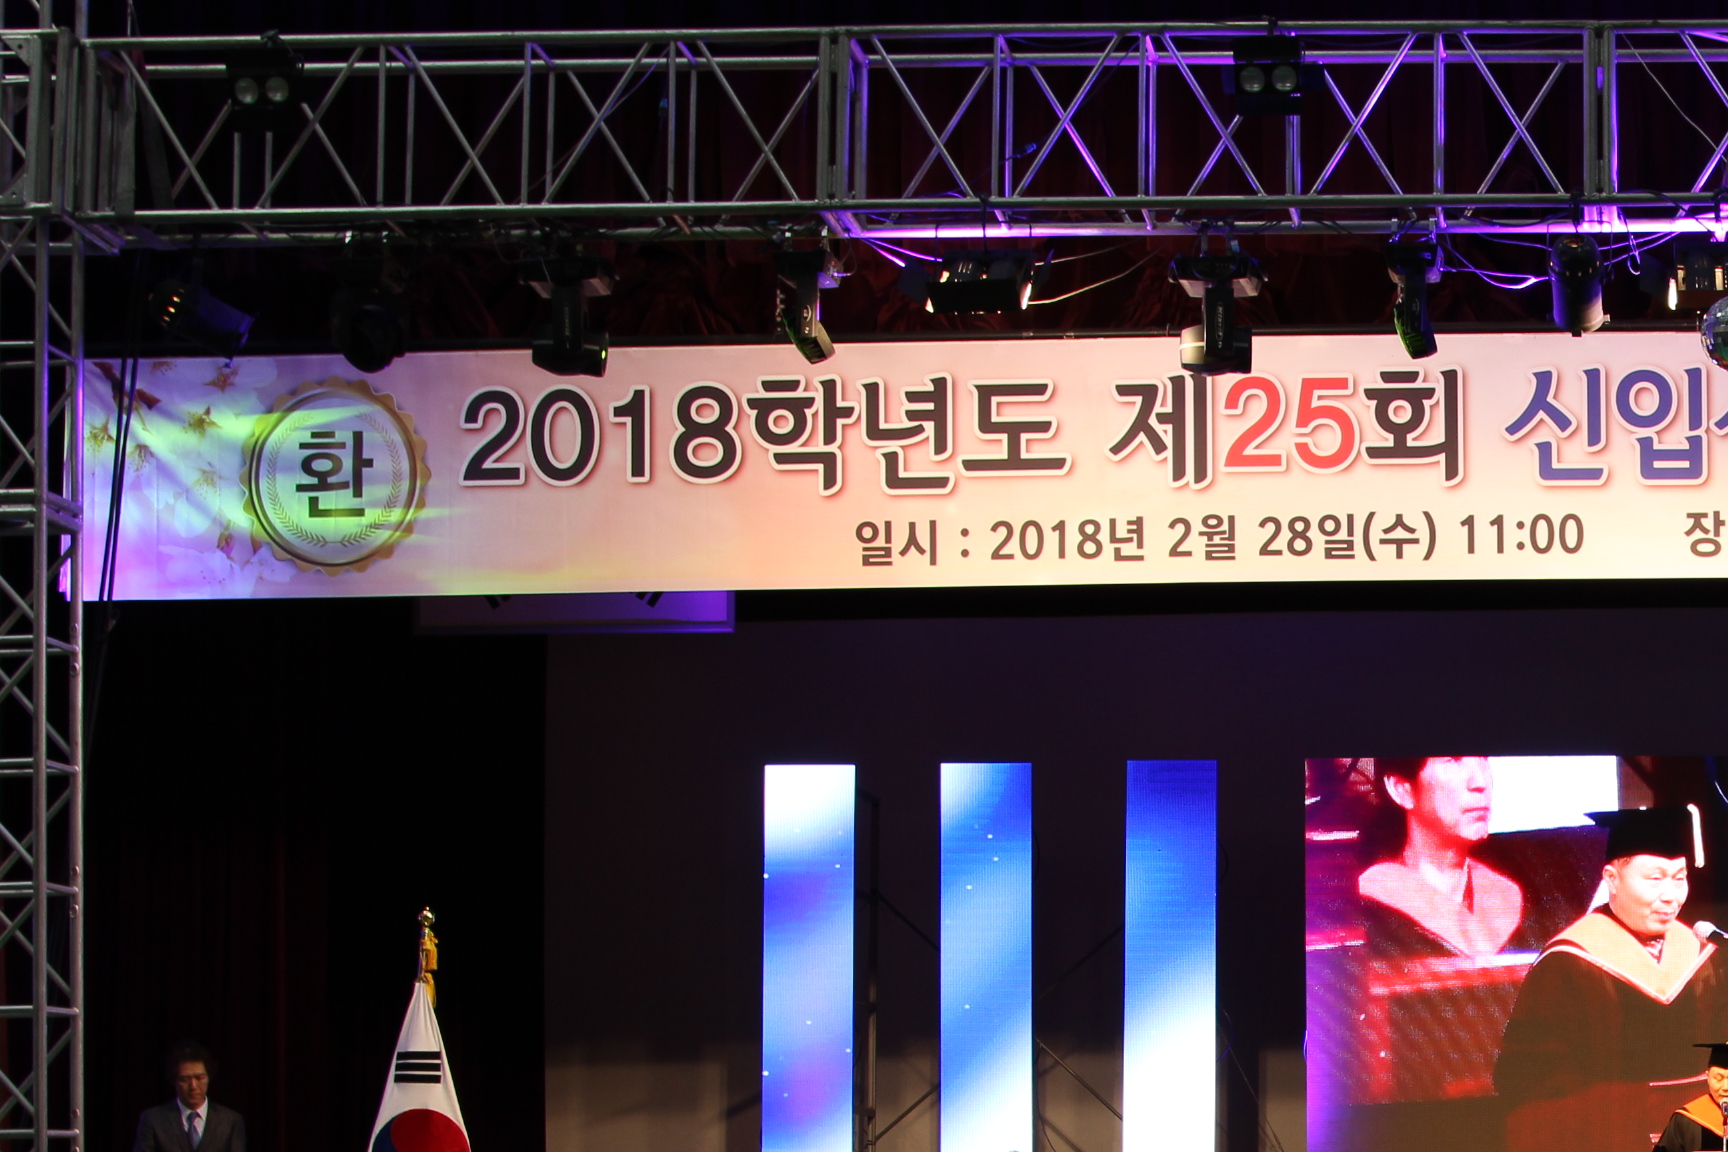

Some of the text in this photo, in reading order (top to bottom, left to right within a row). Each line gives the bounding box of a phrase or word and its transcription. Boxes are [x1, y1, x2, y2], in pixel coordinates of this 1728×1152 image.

[295, 430, 374, 518] 환
[461, 371, 1069, 494] 2018학년도
[1108, 367, 1461, 489] 제25회
[855, 519, 937, 566] 일시
[990, 515, 1145, 562] 2018년
[1168, 513, 1237, 561] 2월
[1258, 510, 1437, 562] 28일(수)
[1460, 513, 1584, 554] 11:00
